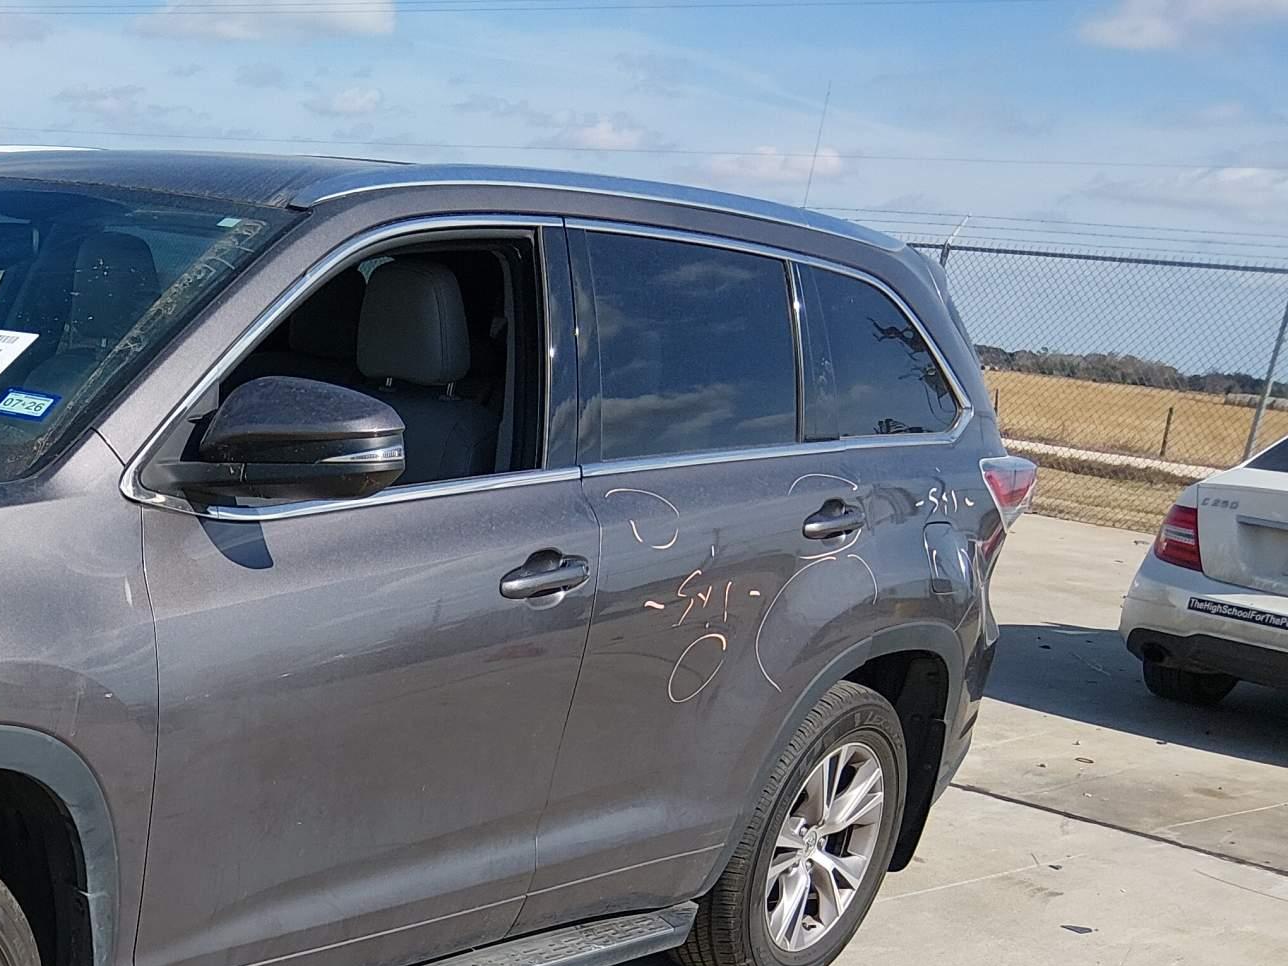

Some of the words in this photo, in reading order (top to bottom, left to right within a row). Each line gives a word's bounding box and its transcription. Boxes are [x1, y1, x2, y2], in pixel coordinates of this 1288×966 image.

[3, 397, 23, 408] 07
[24, 401, 45, 412] 26
[1201, 497, 1210, 506] C
